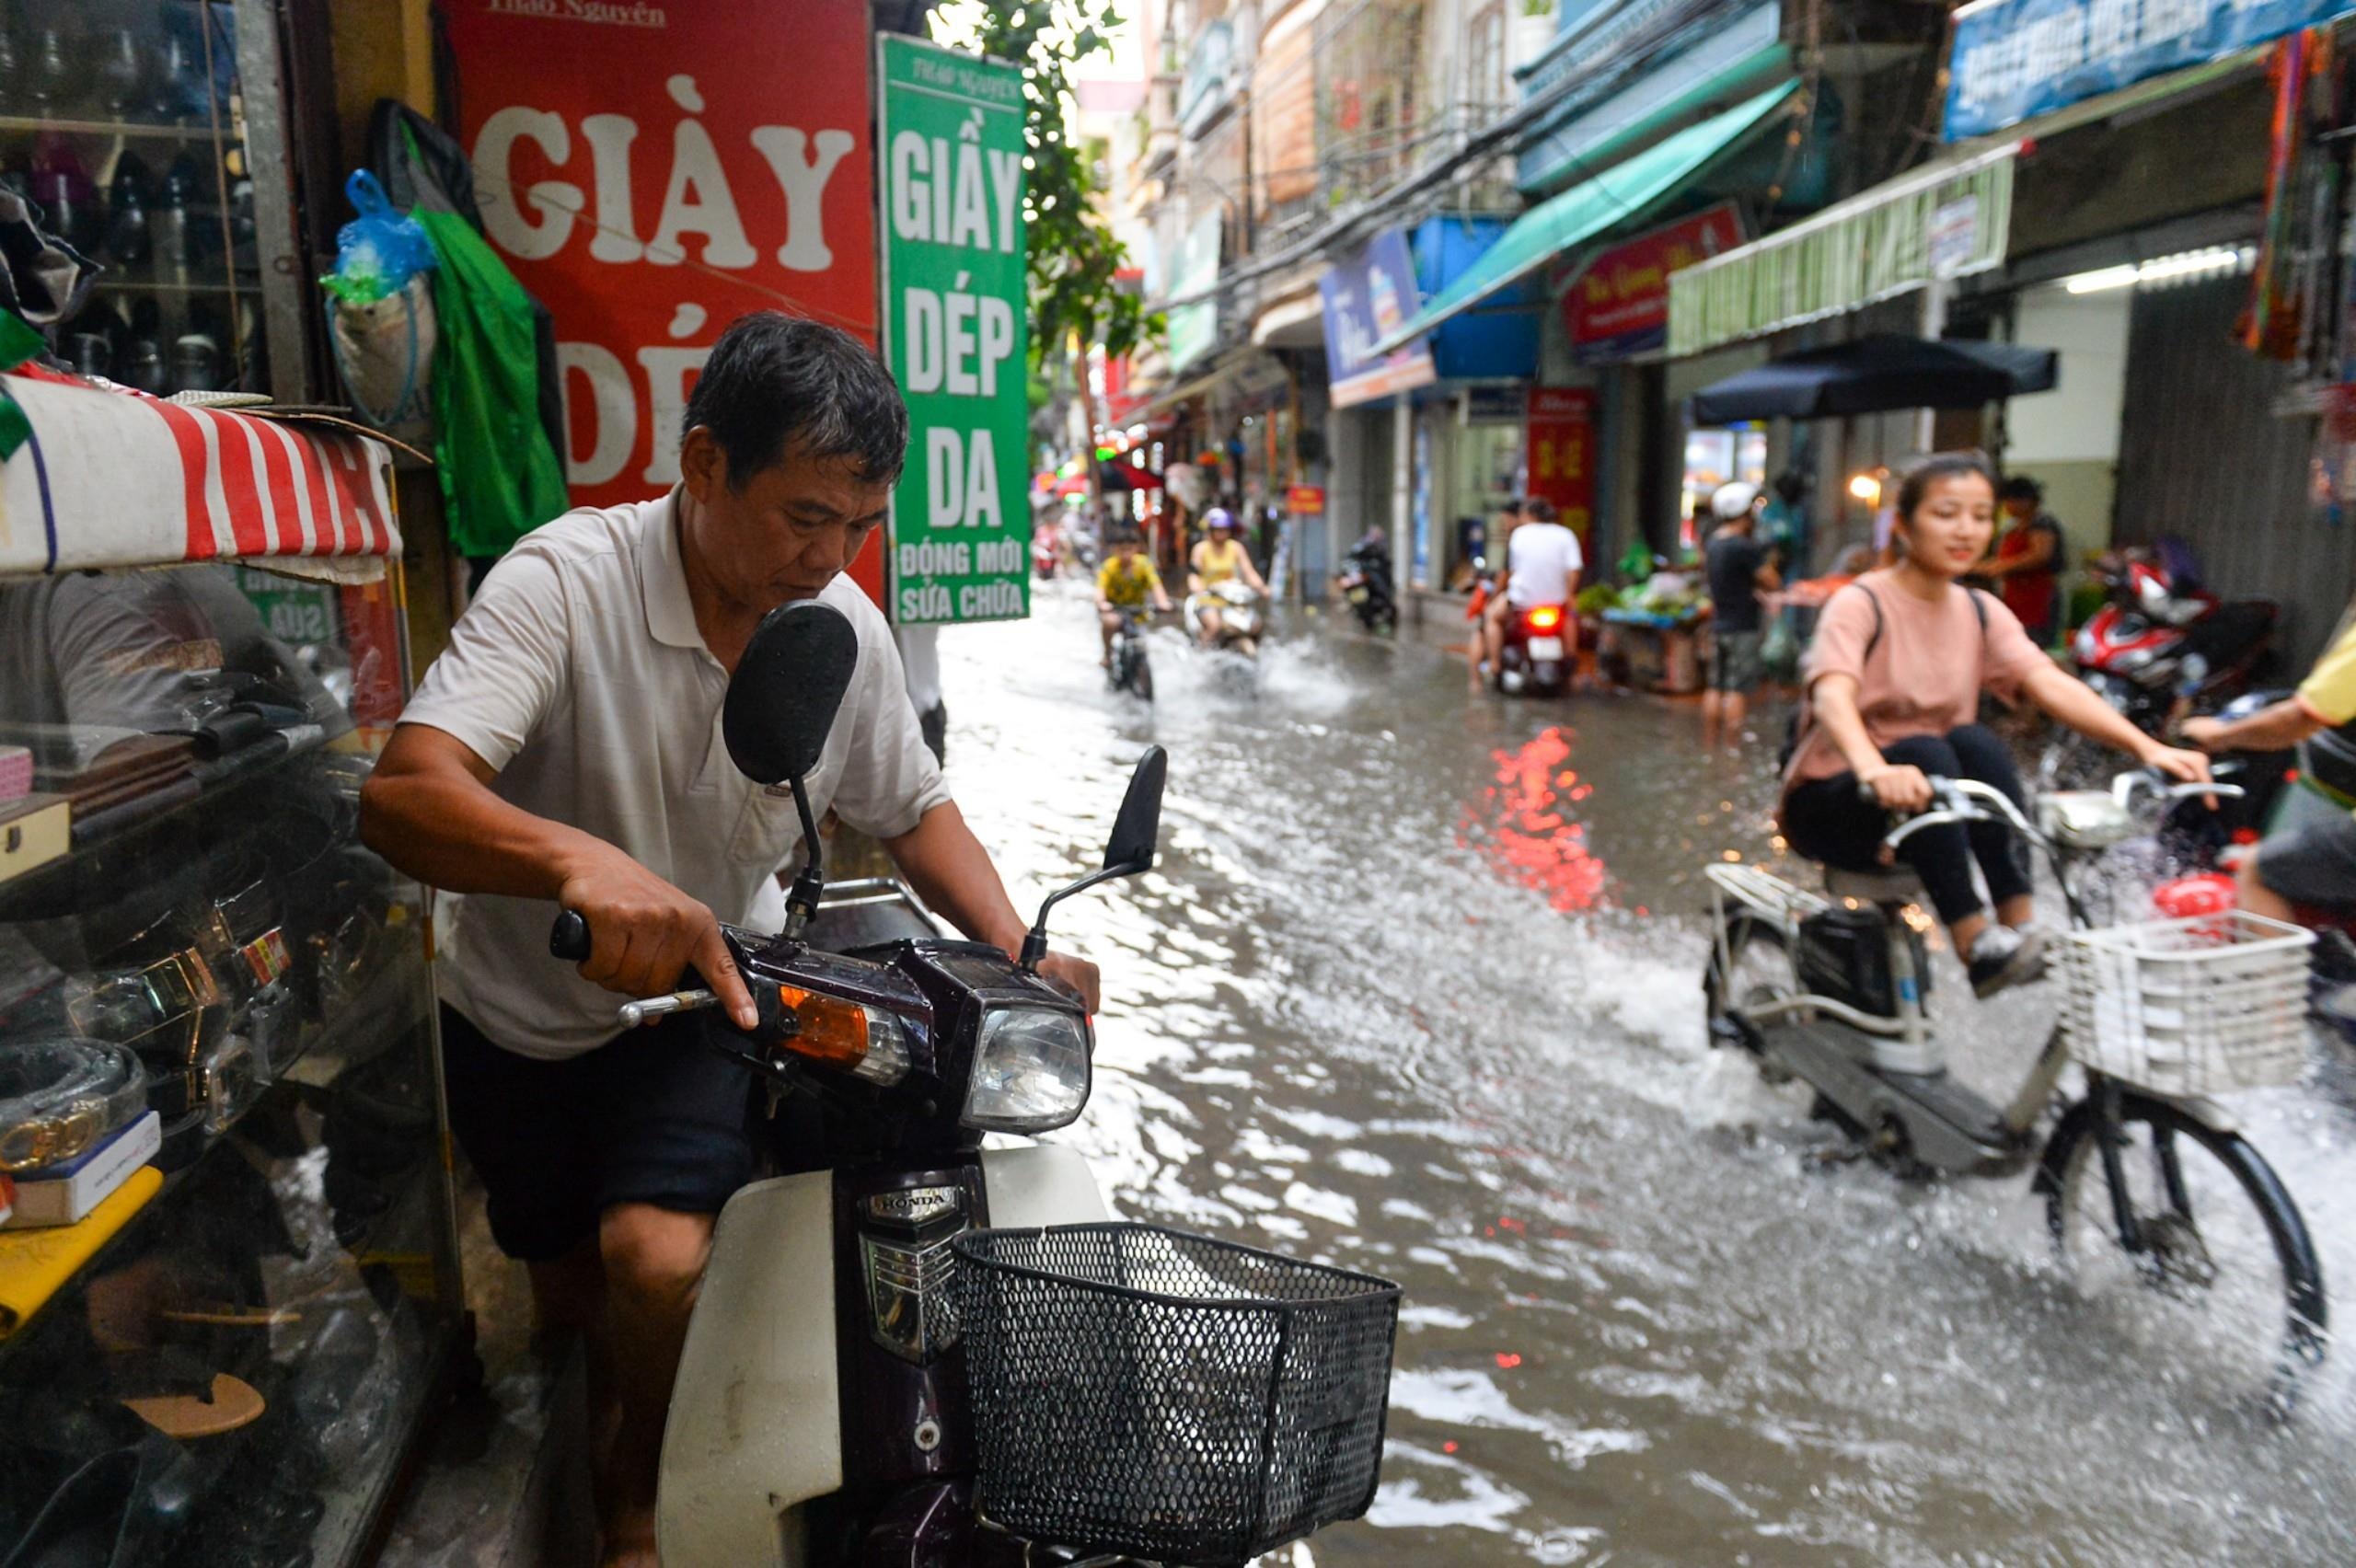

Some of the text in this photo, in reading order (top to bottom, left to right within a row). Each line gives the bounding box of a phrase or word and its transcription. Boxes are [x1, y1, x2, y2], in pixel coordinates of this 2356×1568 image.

[472, 75, 855, 271] GIÀY
[892, 106, 1022, 253] GIẦY
[905, 271, 1014, 397] DÉP
[556, 302, 712, 485] DÉ
[927, 427, 1002, 528] DA
[899, 535, 1023, 576] ĐÓNG MỚI
[901, 576, 1024, 620] SỬA CHỮA
[883, 1195, 944, 1209] HONDA
